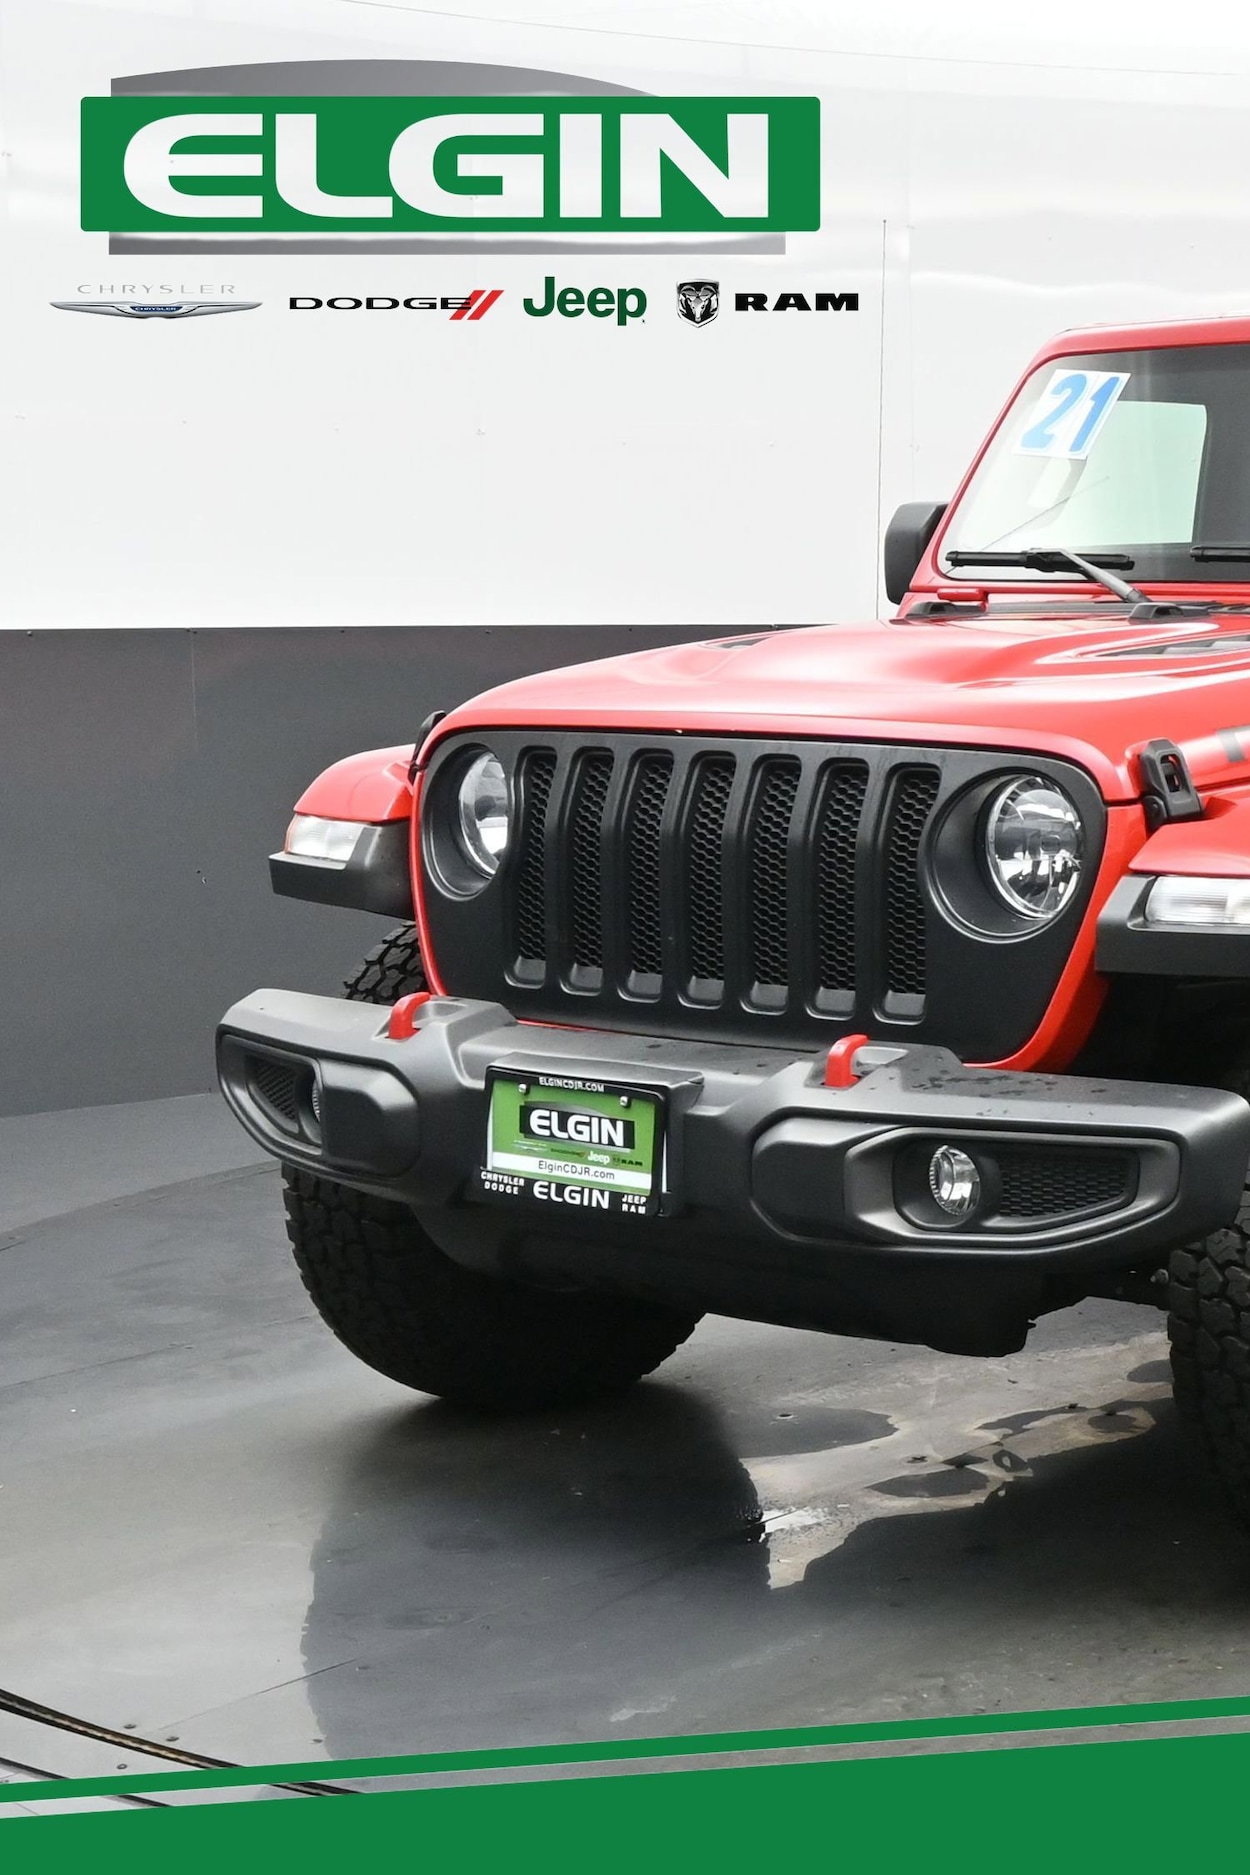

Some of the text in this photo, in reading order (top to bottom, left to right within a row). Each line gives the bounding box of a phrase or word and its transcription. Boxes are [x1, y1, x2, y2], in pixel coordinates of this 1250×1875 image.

[1020, 373, 1120, 452] 21
[538, 1077, 605, 1093] ELGINCDJR.COM
[529, 1109, 624, 1147] ELGIN
[587, 1150, 611, 1165] Jeep
[538, 1160, 615, 1180] ElginCDJR.com
[480, 1171, 525, 1187] CHRYSLER
[484, 1181, 519, 1195] DODGE
[533, 1181, 610, 1209] ELGIN
[621, 1194, 647, 1204] JEEP
[621, 1203, 647, 1214] RAM
